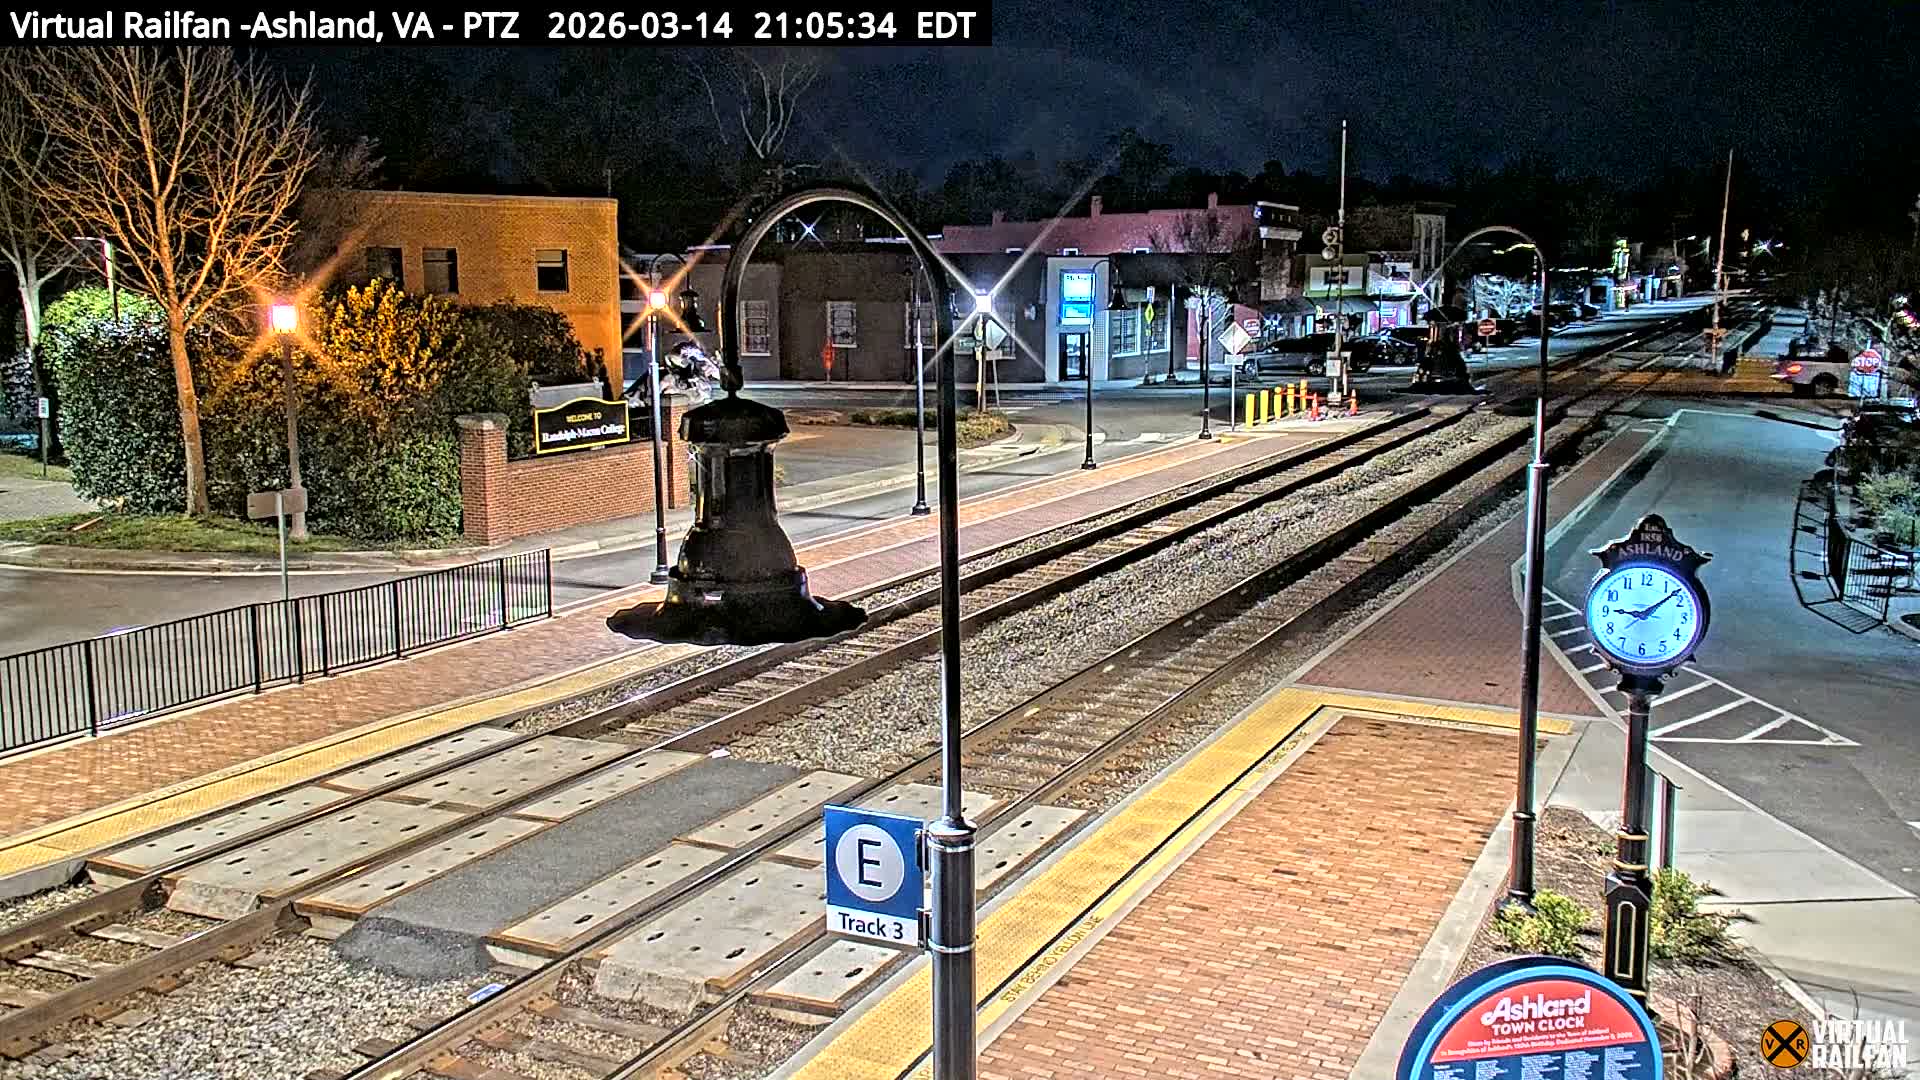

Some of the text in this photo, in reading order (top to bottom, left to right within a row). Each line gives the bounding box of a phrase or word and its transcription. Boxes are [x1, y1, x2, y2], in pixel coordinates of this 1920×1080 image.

[1854, 356, 1880, 367] STOP
[566, 412, 602, 423] WELCOME TO
[600, 423, 626, 435] College
[1618, 543, 1684, 562] ASHLAND
[1623, 577, 1632, 590] 11
[1641, 573, 1653, 587] 12
[1607, 590, 1619, 602] 10
[1675, 595, 1684, 608] 2
[1602, 605, 1610, 617] 9
[1680, 612, 1688, 625] 3
[1606, 622, 1614, 635] 8
[1673, 628, 1681, 641] 4
[1618, 637, 1626, 649] 7
[1638, 643, 1646, 656] 6
[1658, 640, 1668, 653] 5
[857, 838, 882, 888] E
[838, 912, 904, 940] Track 3
[1480, 989, 1591, 1026] Ashland
[1491, 1015, 1585, 1036] TOWN CLOCK
